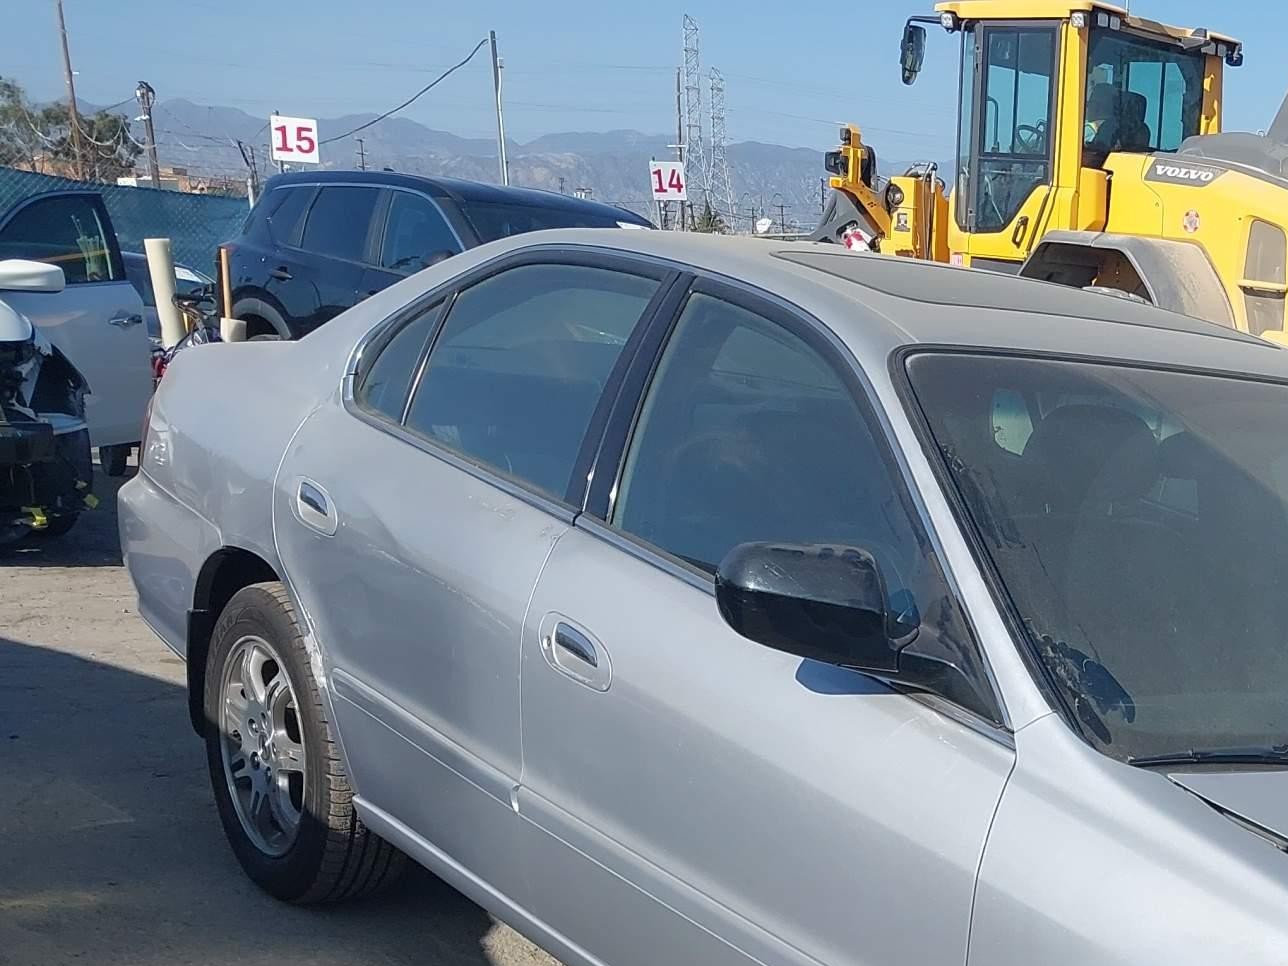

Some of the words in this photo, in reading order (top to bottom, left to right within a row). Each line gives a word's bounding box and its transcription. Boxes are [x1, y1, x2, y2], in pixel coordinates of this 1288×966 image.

[274, 125, 315, 154] 15
[652, 168, 684, 193] 14
[1155, 164, 1214, 182] VOLVO
